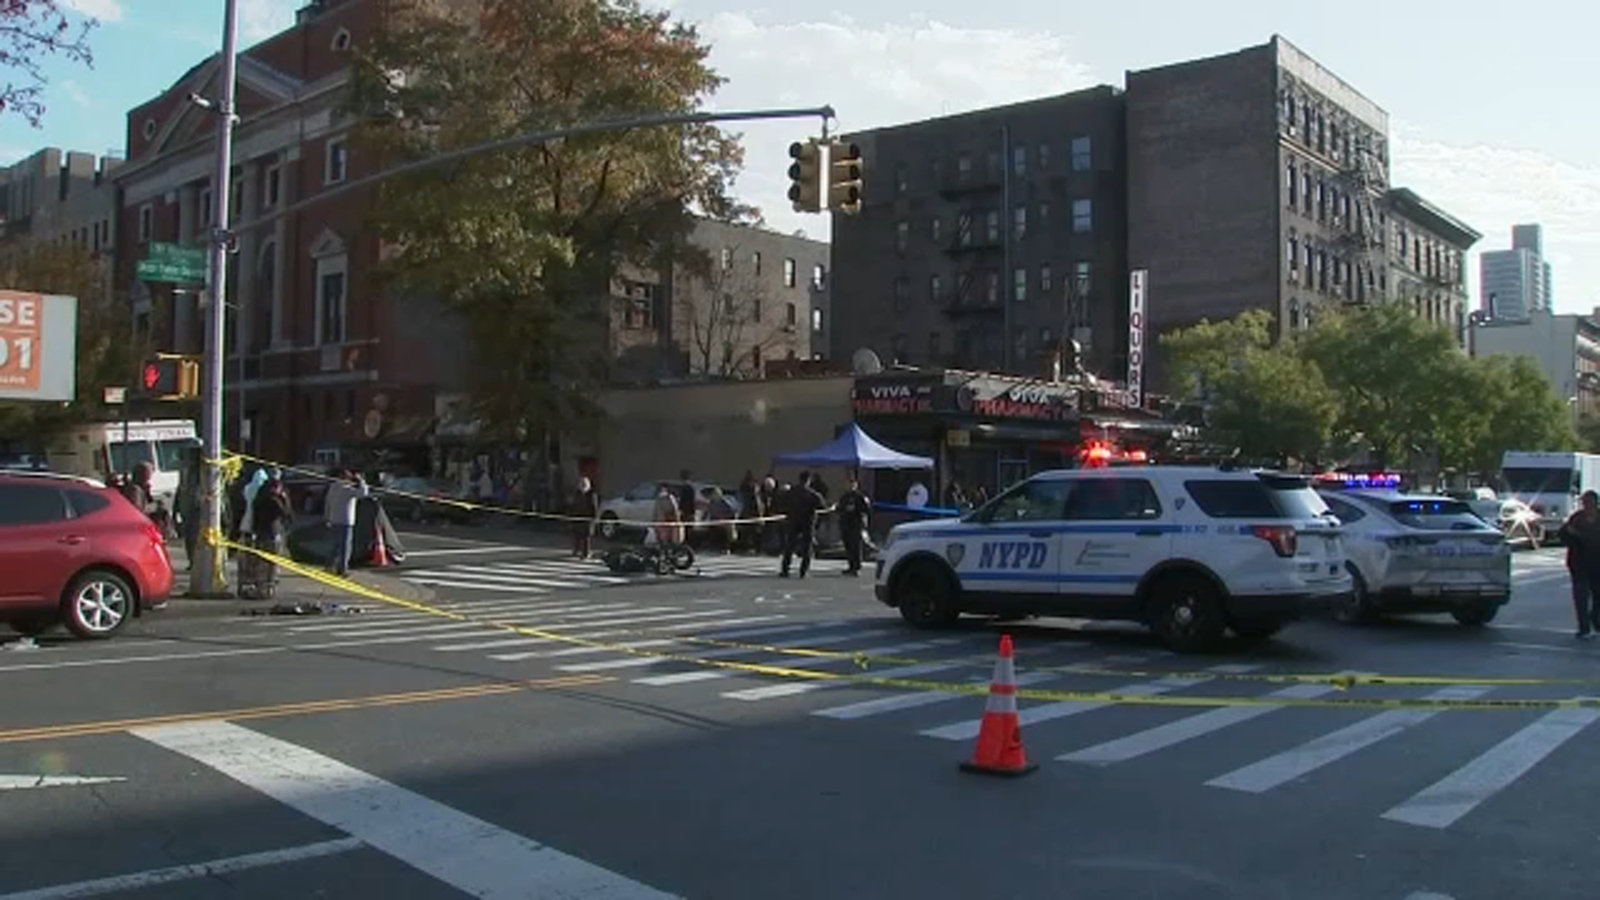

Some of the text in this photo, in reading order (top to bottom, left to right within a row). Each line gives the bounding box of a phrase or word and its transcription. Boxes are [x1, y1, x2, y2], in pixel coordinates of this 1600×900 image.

[1129, 274, 1141, 405] LIQUORS
[871, 386, 911, 398] VIVA
[979, 542, 1048, 569] NYPD
